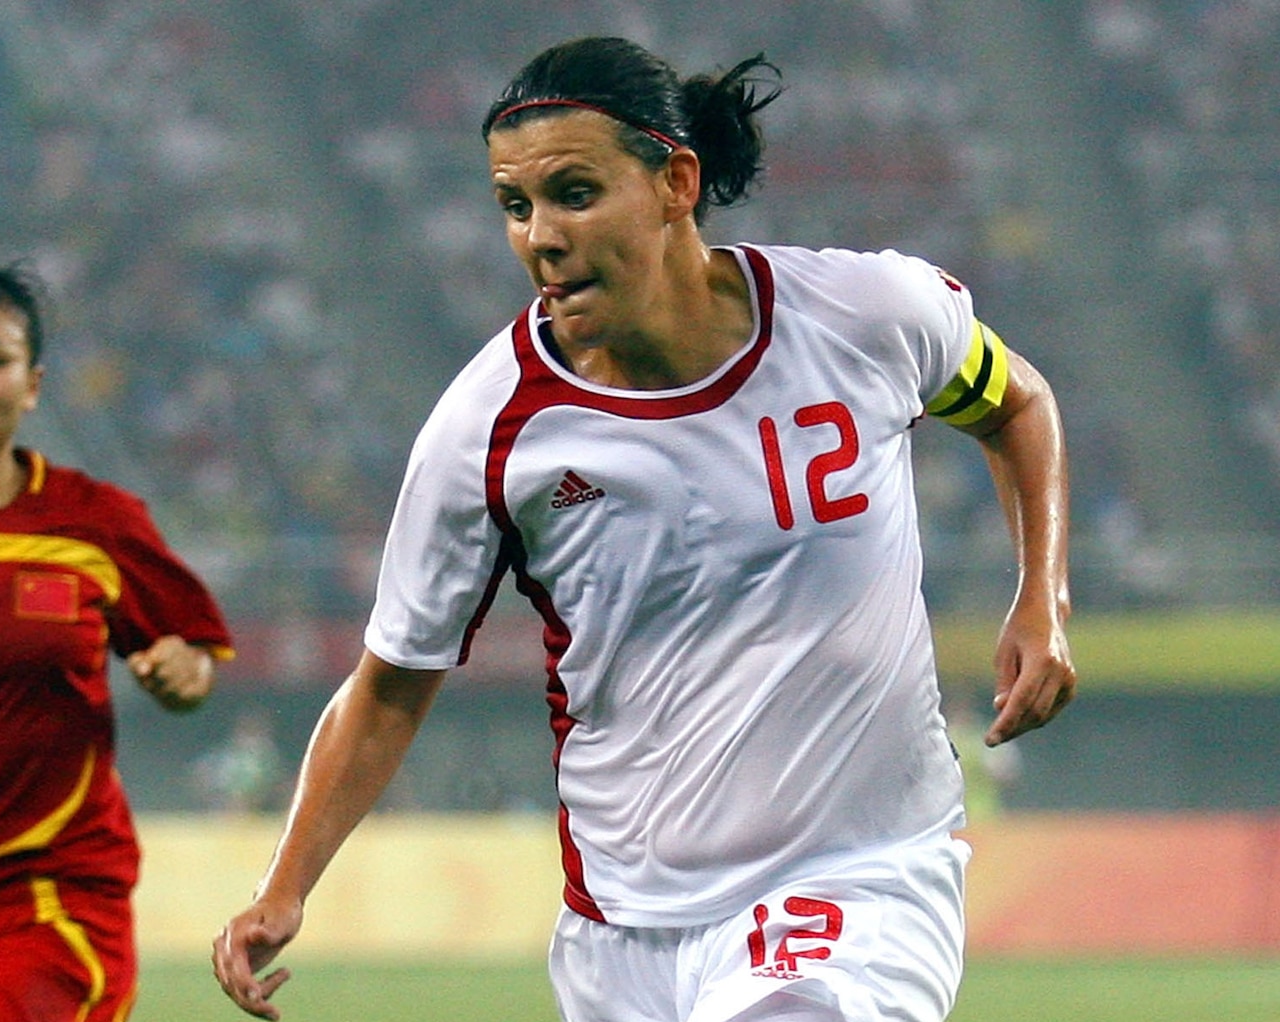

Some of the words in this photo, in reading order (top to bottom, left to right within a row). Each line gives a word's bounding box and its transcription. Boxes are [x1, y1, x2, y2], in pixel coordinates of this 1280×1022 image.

[551, 488, 606, 509] adidas
[758, 401, 869, 530] 12
[747, 896, 843, 968] 12
